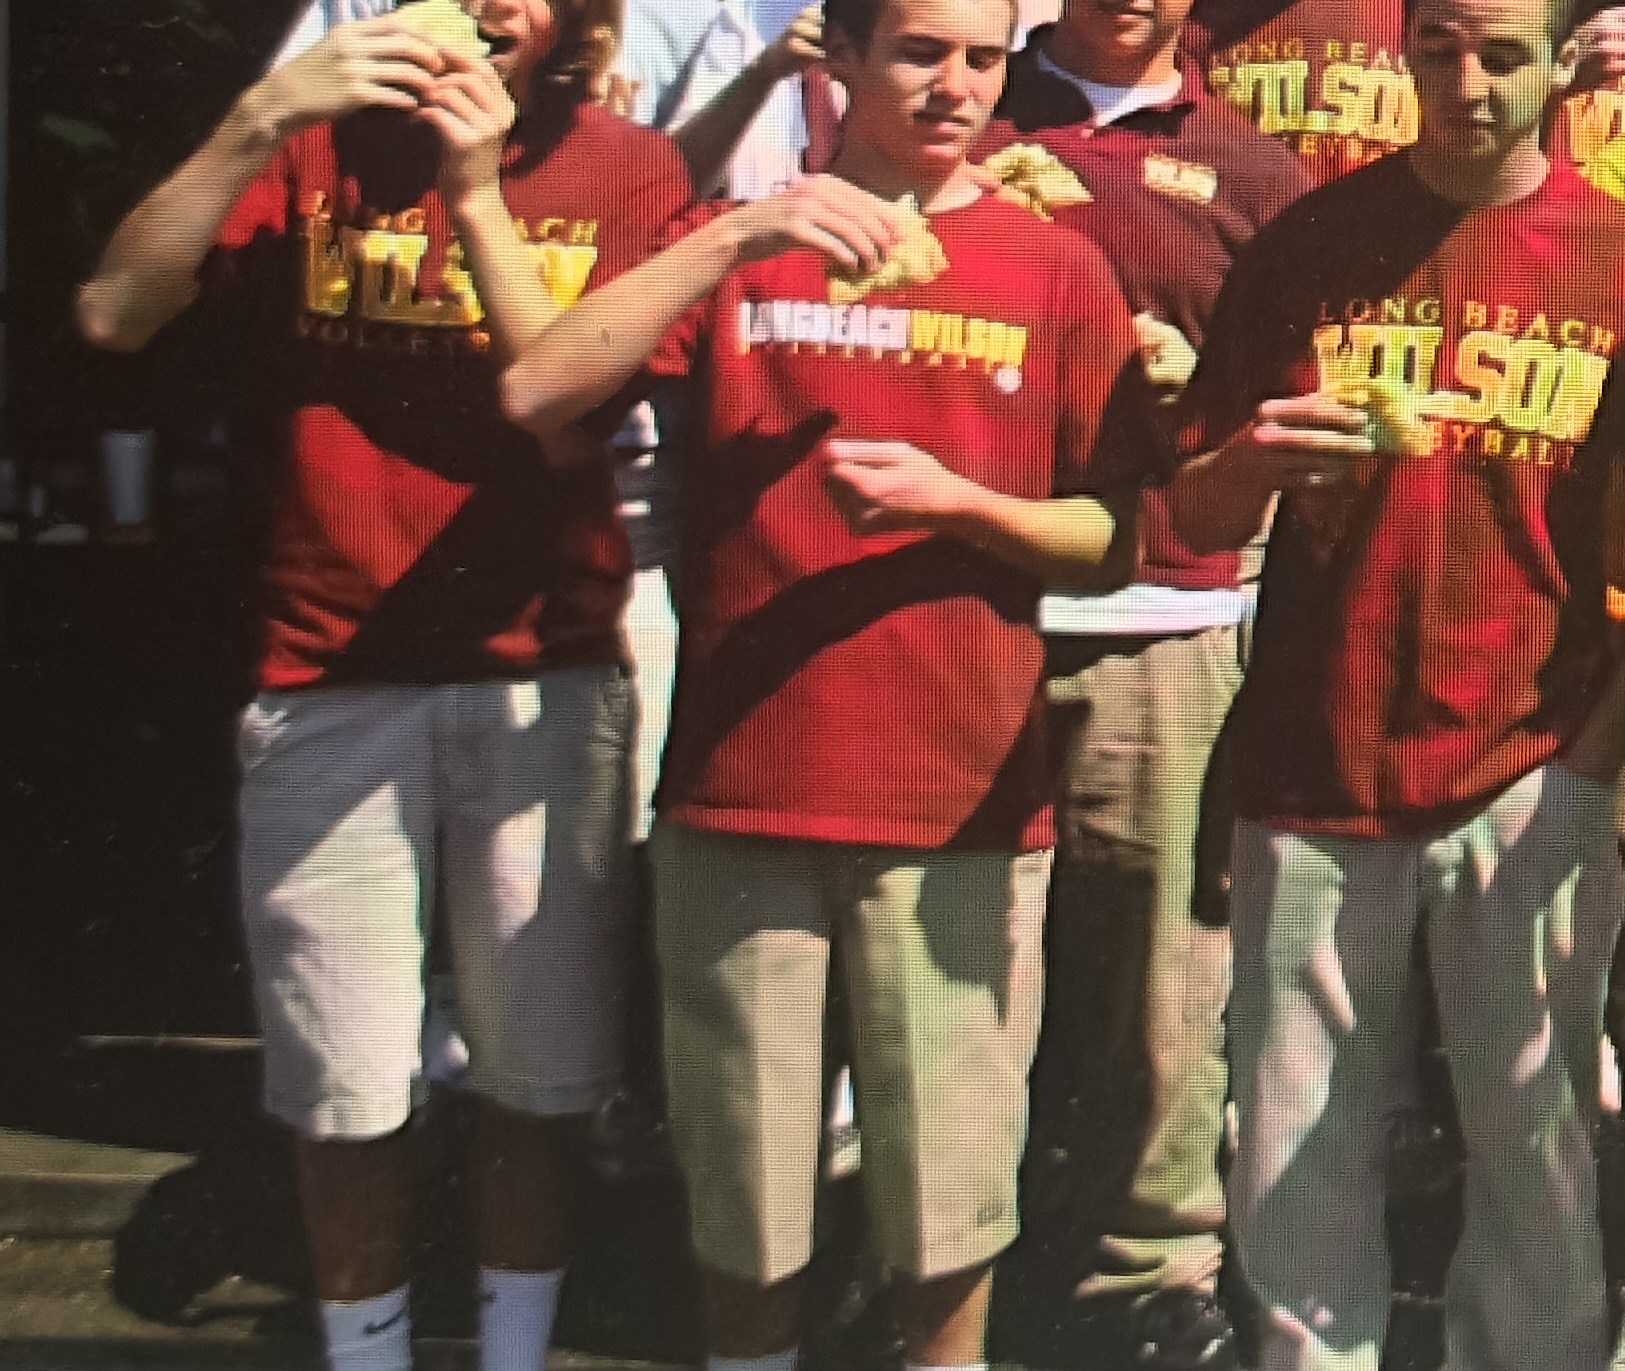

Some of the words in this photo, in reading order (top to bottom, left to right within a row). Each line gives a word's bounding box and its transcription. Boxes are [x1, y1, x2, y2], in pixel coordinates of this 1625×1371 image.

[1318, 296, 1441, 323] LONG
[1462, 299, 1618, 355] BEACH
[1312, 324, 1612, 446] WILSON
